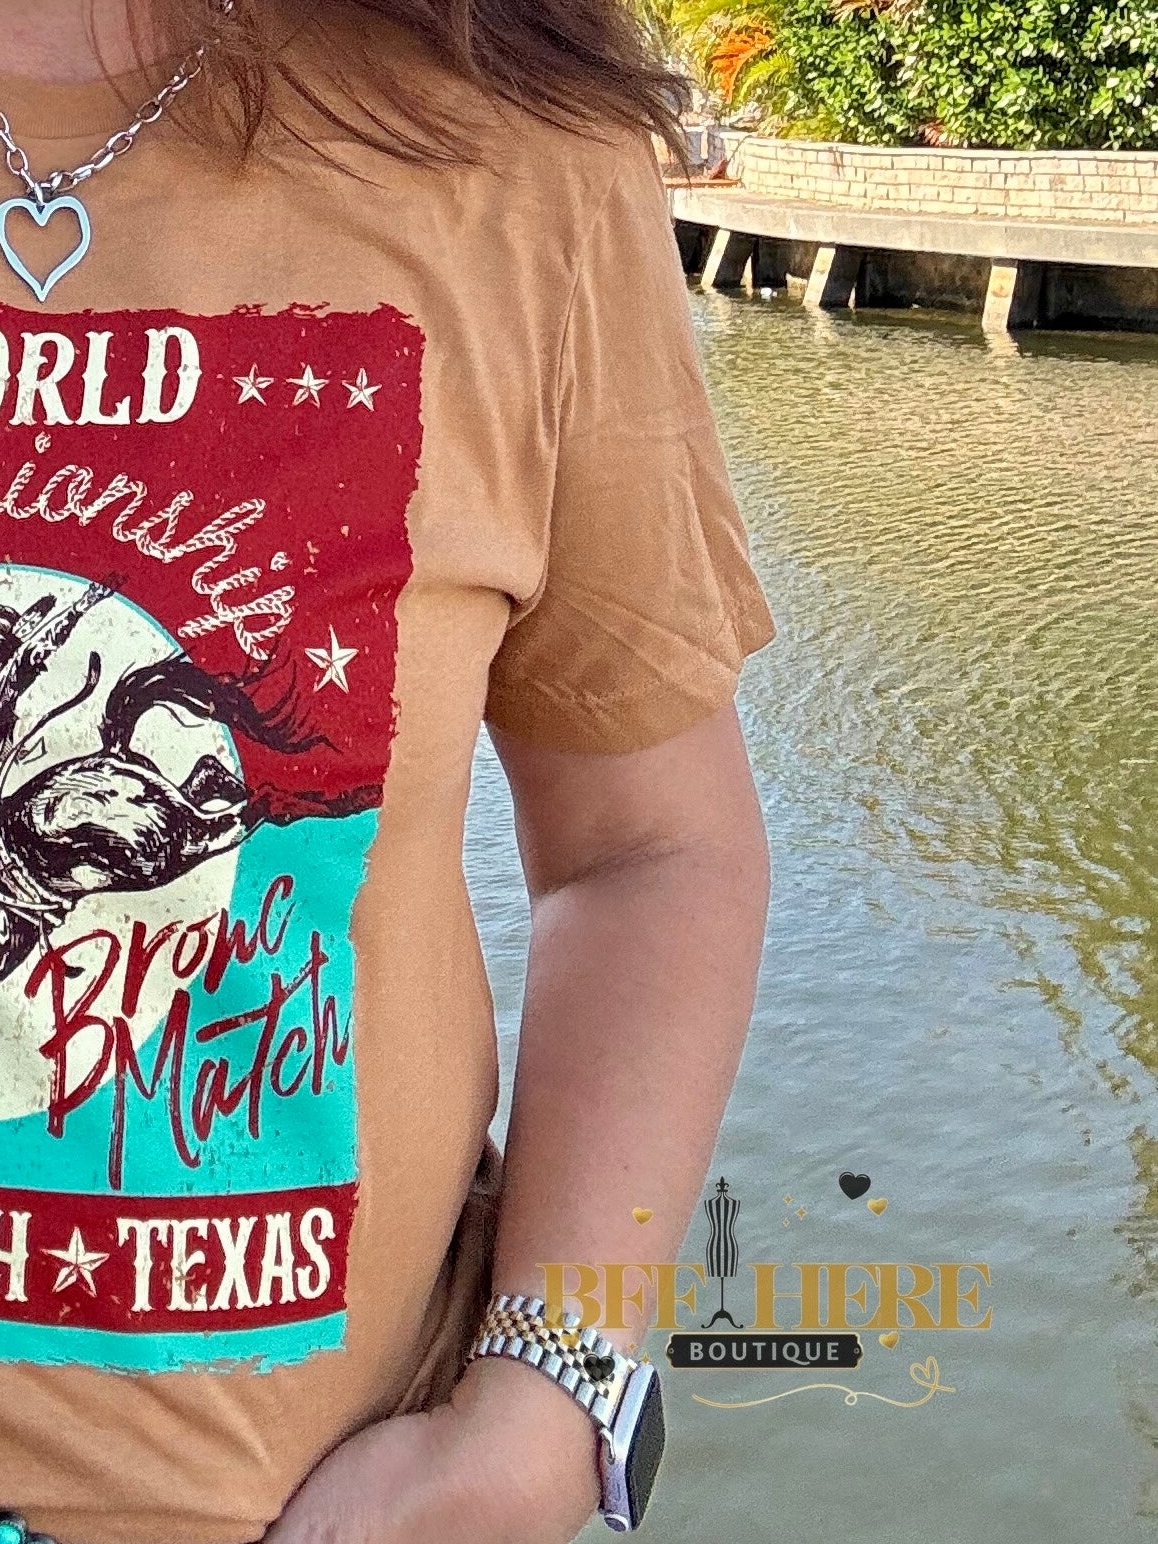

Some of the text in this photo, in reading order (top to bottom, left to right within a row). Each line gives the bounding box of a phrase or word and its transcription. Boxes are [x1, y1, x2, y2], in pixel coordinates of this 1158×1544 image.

[26, 874, 294, 1138] Bronc
[108, 932, 350, 1190] Match
[118, 1207, 336, 1314] TEXAS
